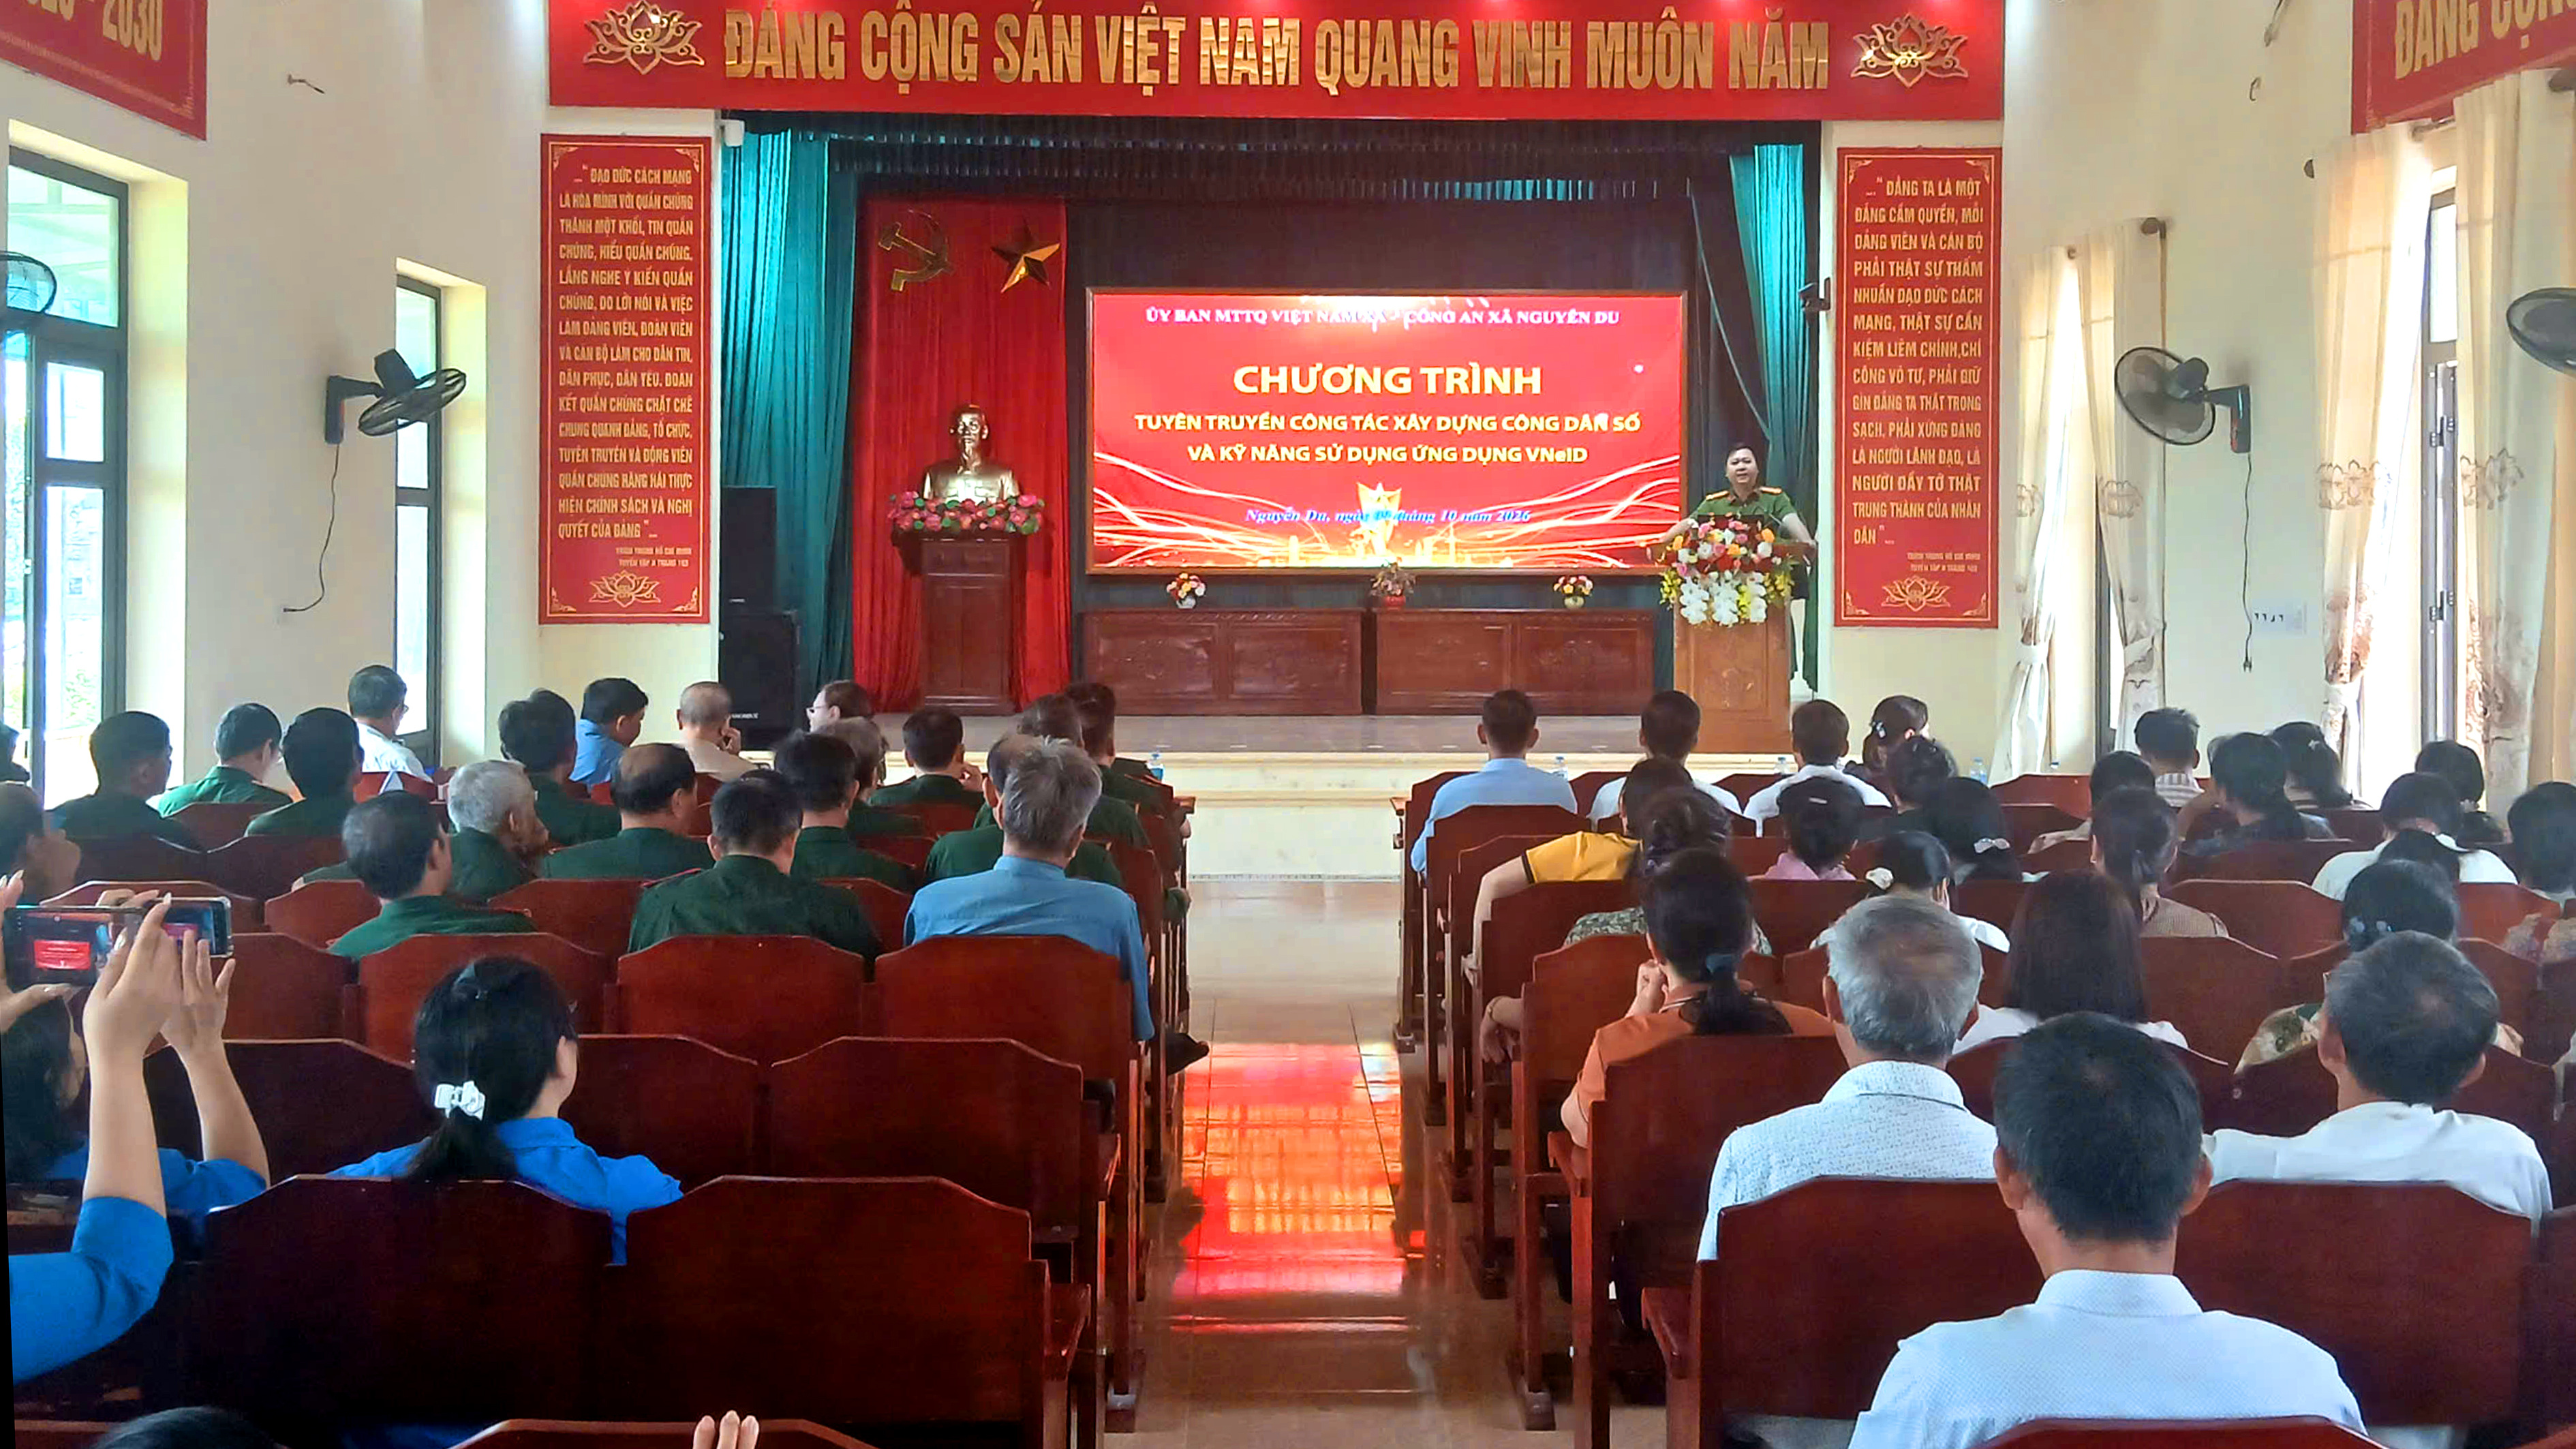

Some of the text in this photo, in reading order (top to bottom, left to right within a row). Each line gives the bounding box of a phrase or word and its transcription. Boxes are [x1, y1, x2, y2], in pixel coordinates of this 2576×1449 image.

[724, 0, 845, 80] ĐẢNG
[861, 0, 979, 94] CỘNG
[1095, 1, 1186, 97] VIỆT
[1199, 16, 1300, 86] NAM
[1315, 19, 1460, 96] QUANG
[1472, 19, 1572, 88] VINH
[1586, 5, 1714, 89] MUÔN
[1728, 6, 1829, 89] NĂM
[1922, 181, 1934, 196] TA
[1174, 309, 1210, 322] BAN
[1215, 309, 1268, 324] MTTQ
[1272, 309, 1313, 326] VIỆT
[1460, 311, 1484, 324] AN
[1595, 311, 1619, 324] DU
[1233, 362, 1542, 394] CHƯƠNG TRÌNH
[1905, 396, 1916, 410] TA
[1948, 395, 1981, 411] TRONG
[1135, 412, 1201, 430] TUYÊN
[1289, 413, 1347, 431] CÔNG
[1351, 412, 1389, 431] TÁC
[1394, 413, 1431, 431] XÂY
[1437, 414, 1497, 434] DỰNG
[1502, 413, 1560, 431] CÔNG
[1564, 413, 1608, 431] DÂN
[1612, 412, 1641, 431] SỐ
[1188, 444, 1588, 465] VÀ KỸ NĂNG SỬ DỤNG ỨNG DỤNG VNeID
[1853, 502, 1887, 518] TRUNG
